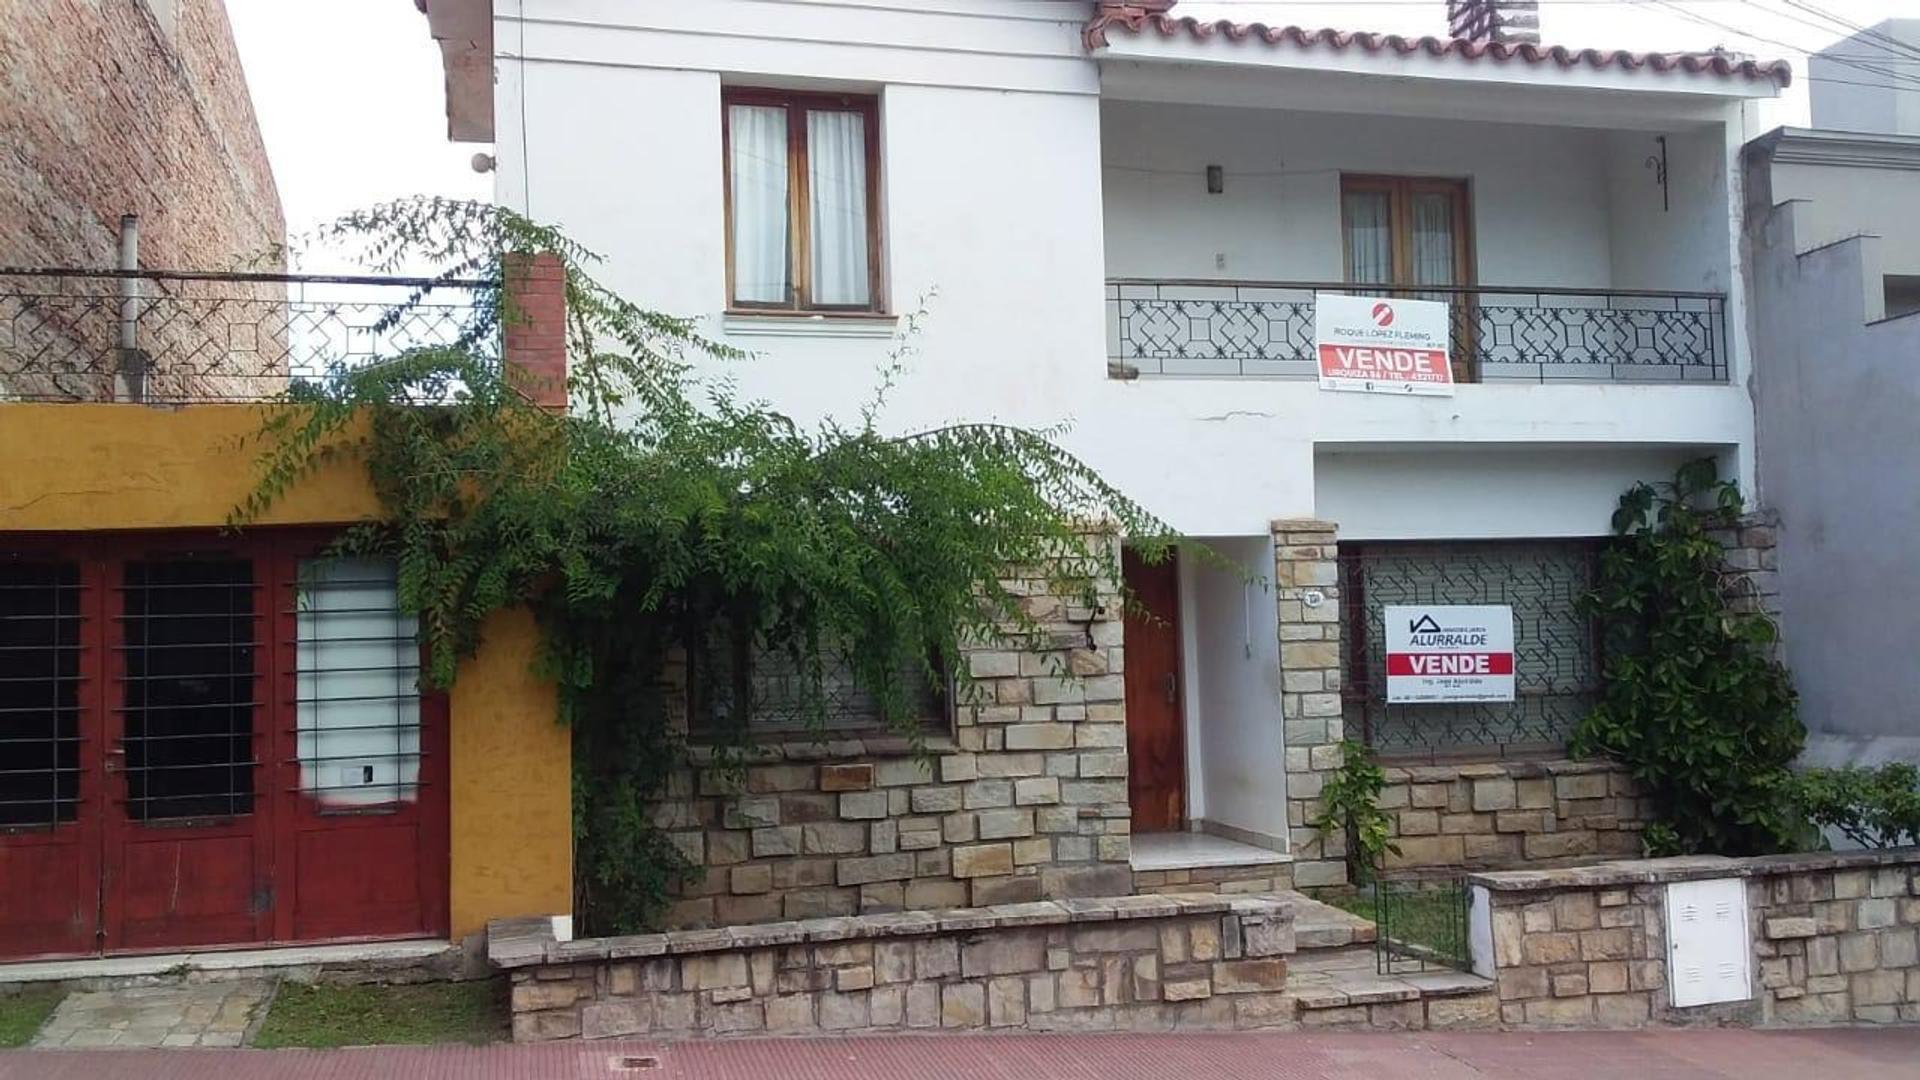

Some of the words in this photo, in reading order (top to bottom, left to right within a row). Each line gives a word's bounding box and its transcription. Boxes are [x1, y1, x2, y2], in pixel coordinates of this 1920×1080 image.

[1334, 327, 1363, 337] ROQUE
[1395, 330, 1431, 341] FLEMING
[1336, 347, 1433, 373] VENDE
[1410, 634, 1488, 646] ALURRALDE
[1408, 655, 1490, 674] VENDE
